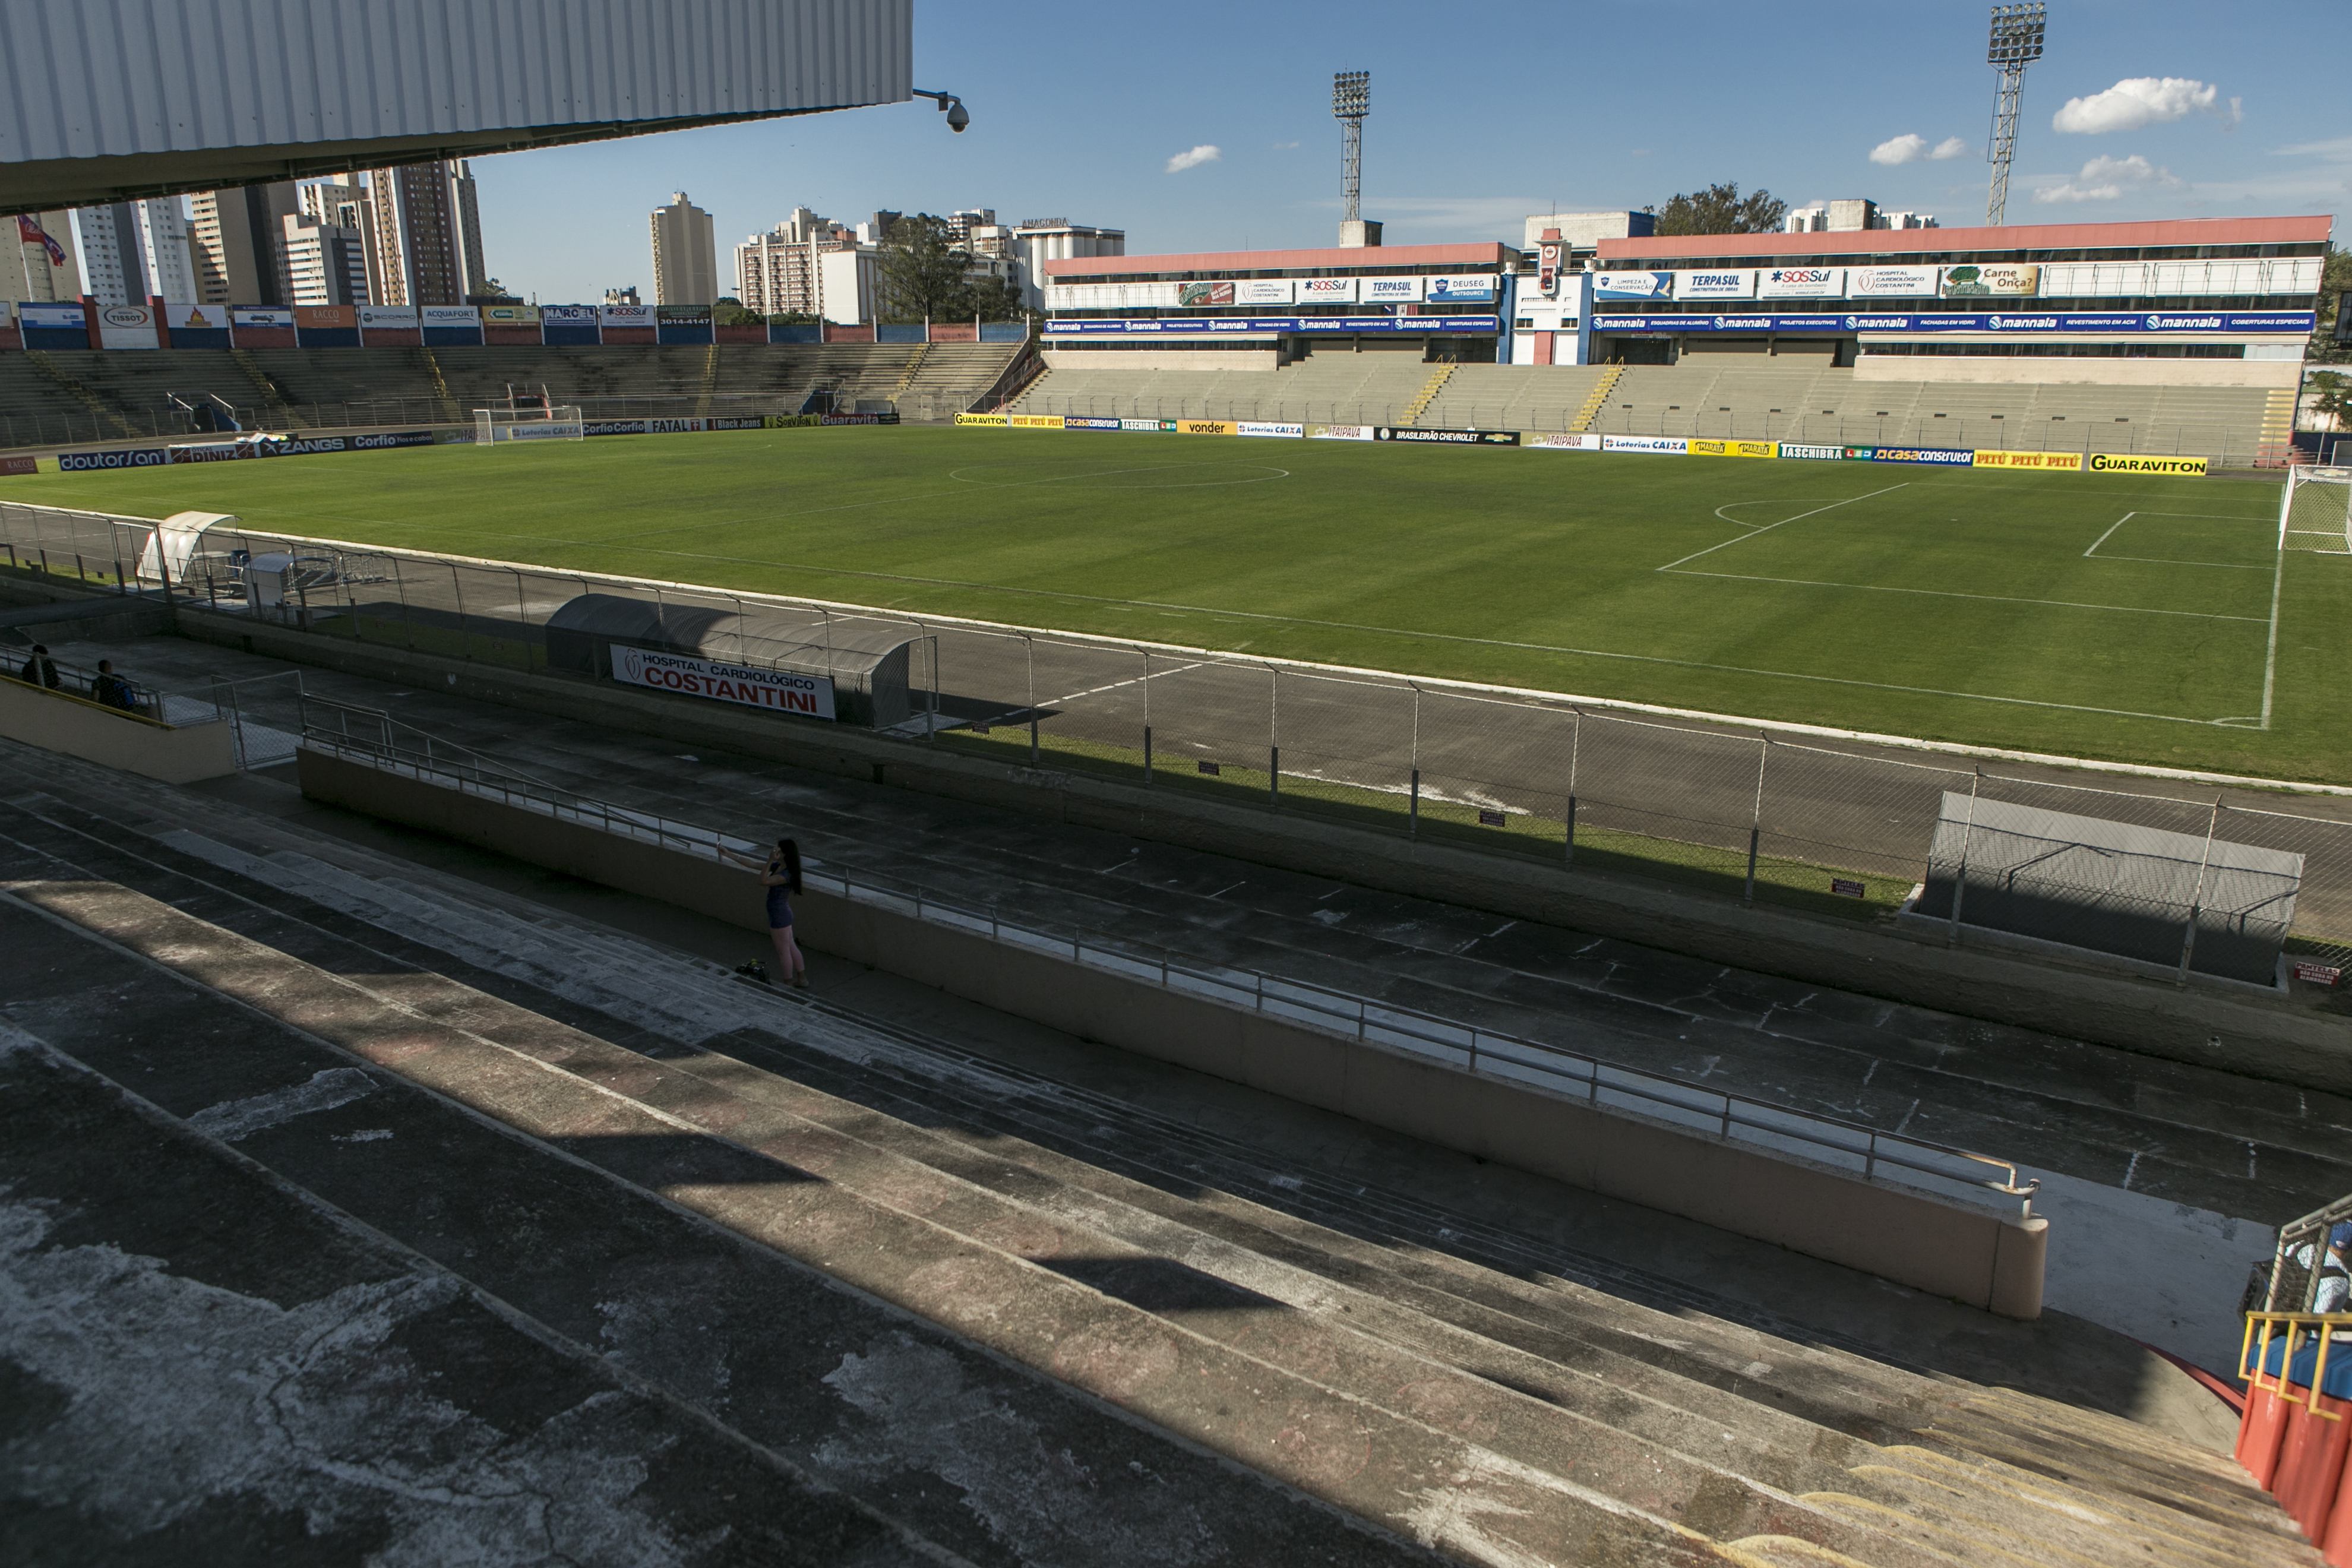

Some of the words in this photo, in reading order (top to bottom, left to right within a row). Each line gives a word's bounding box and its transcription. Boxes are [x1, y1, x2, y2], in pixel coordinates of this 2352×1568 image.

[1022, 217, 1068, 228] ANACONDA
[1782, 270, 1831, 283] SOSSul
[1984, 269, 2017, 277] Carne
[1313, 280, 1348, 290] SOSSul
[1692, 275, 1740, 286] TERPASUL
[1997, 278, 2032, 289] Onça?
[1373, 282, 1412, 291] TERPASUL
[312, 309, 339, 319] RACCO
[546, 308, 593, 318] NARCEL
[615, 307, 647, 316] SOSSul
[717, 419, 738, 429] Black
[739, 418, 761, 428] Jeans
[821, 415, 879, 425] Guaravita
[956, 414, 1007, 425] GUARAVITON
[1120, 418, 1159, 431] TASCHIBRA
[552, 426, 580, 435] CAIXA
[583, 423, 613, 434] Corfio
[614, 422, 644, 432] Corfio
[652, 420, 688, 433] FATAL
[1189, 421, 1225, 434] vonder
[1275, 426, 1302, 434] CAIXA
[1329, 426, 1361, 438] ITAIPAVA
[355, 435, 396, 447] Corfio
[1396, 431, 1439, 441] BRASILEIRÃO
[1439, 433, 1479, 442] CHEVROLET
[1547, 434, 1582, 447] ITAIPAVA
[279, 438, 345, 454] ZANGS
[1652, 441, 1687, 450] CAIXA
[192, 450, 236, 463] DINIZ
[1781, 443, 1845, 460] TASCHIBRA
[1887, 449, 1919, 461] casa
[1918, 450, 1973, 463] construtor
[7, 460, 34, 469] RACCO
[1975, 452, 2008, 464] PITÚ
[2010, 453, 2042, 466] PITÚ
[2046, 454, 2081, 467] PITÚ
[2091, 454, 2206, 473] GUARAVITON
[643, 654, 704, 673] HOSPITAL
[710, 666, 815, 690] CARDIOLÓGICO
[644, 667, 817, 713] COSTANTINI
[2296, 962, 2339, 975] PANTELAS
[2299, 975, 2332, 985] ALAMBRADO
